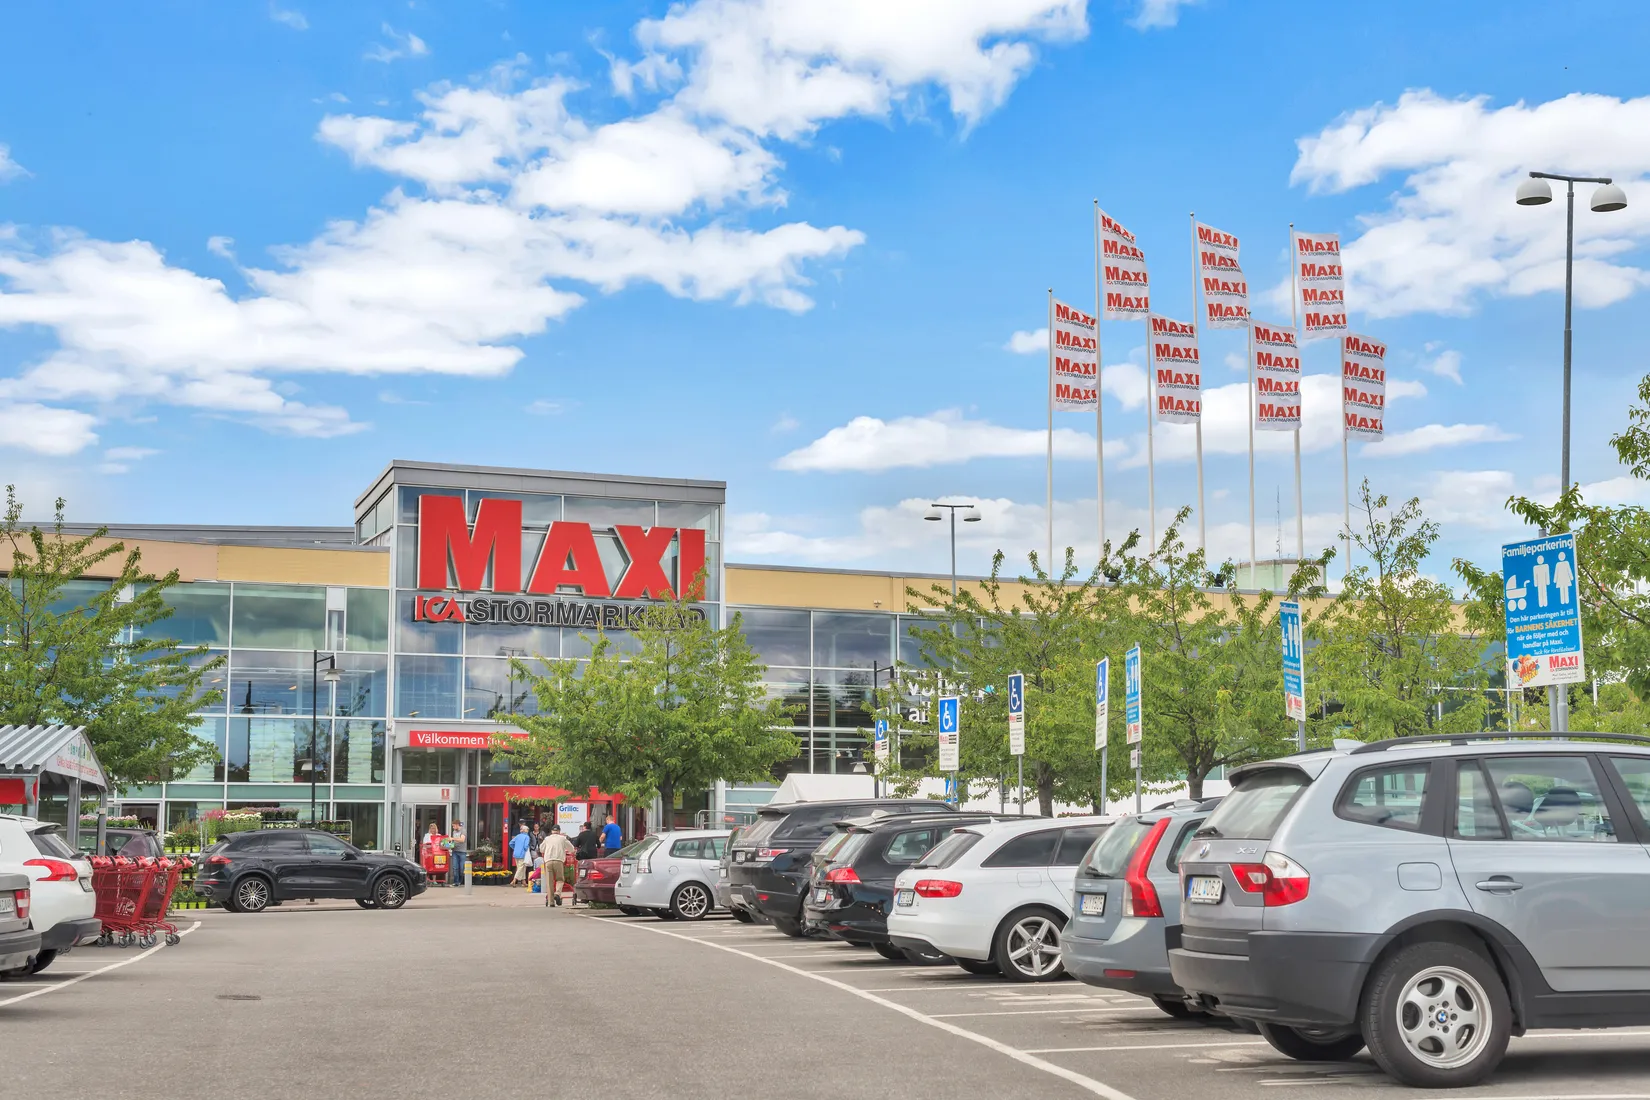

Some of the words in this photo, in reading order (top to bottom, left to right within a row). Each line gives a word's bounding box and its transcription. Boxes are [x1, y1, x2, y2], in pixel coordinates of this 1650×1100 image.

[1198, 227, 1238, 247] MAXI
[1298, 239, 1339, 252] MAXI
[1105, 266, 1147, 283] MAXI
[1302, 264, 1342, 276] MAXI
[1204, 278, 1246, 293] MAXI
[1107, 293, 1148, 308] MAXI
[1303, 289, 1343, 301] MAXI
[1208, 304, 1246, 317] MAXI
[1152, 318, 1194, 333] MAXI
[1306, 313, 1346, 326] MAXI
[1056, 330, 1096, 349] MAXI
[1346, 336, 1385, 357] MAXI
[1155, 344, 1198, 359] MAXI
[1056, 357, 1096, 374] MAXI
[1257, 352, 1299, 369] MAXI
[1158, 370, 1199, 385] MAXI
[1344, 361, 1384, 381] MAXI
[1258, 378, 1298, 392] MAXI
[1159, 396, 1199, 412] MAXI
[1344, 387, 1383, 406] MAXI
[1260, 404, 1300, 417] MAXI
[418, 495, 705, 601] MAXI
[1502, 539, 1573, 558] Familjeparkering
[416, 596, 466, 622] ICA
[1530, 612, 1559, 622] parkeringen
[1515, 623, 1544, 633] BARNENS
[1545, 618, 1578, 629] SÄKERHET
[1549, 656, 1578, 668] MAXI
[417, 733, 484, 745] Välkommen
